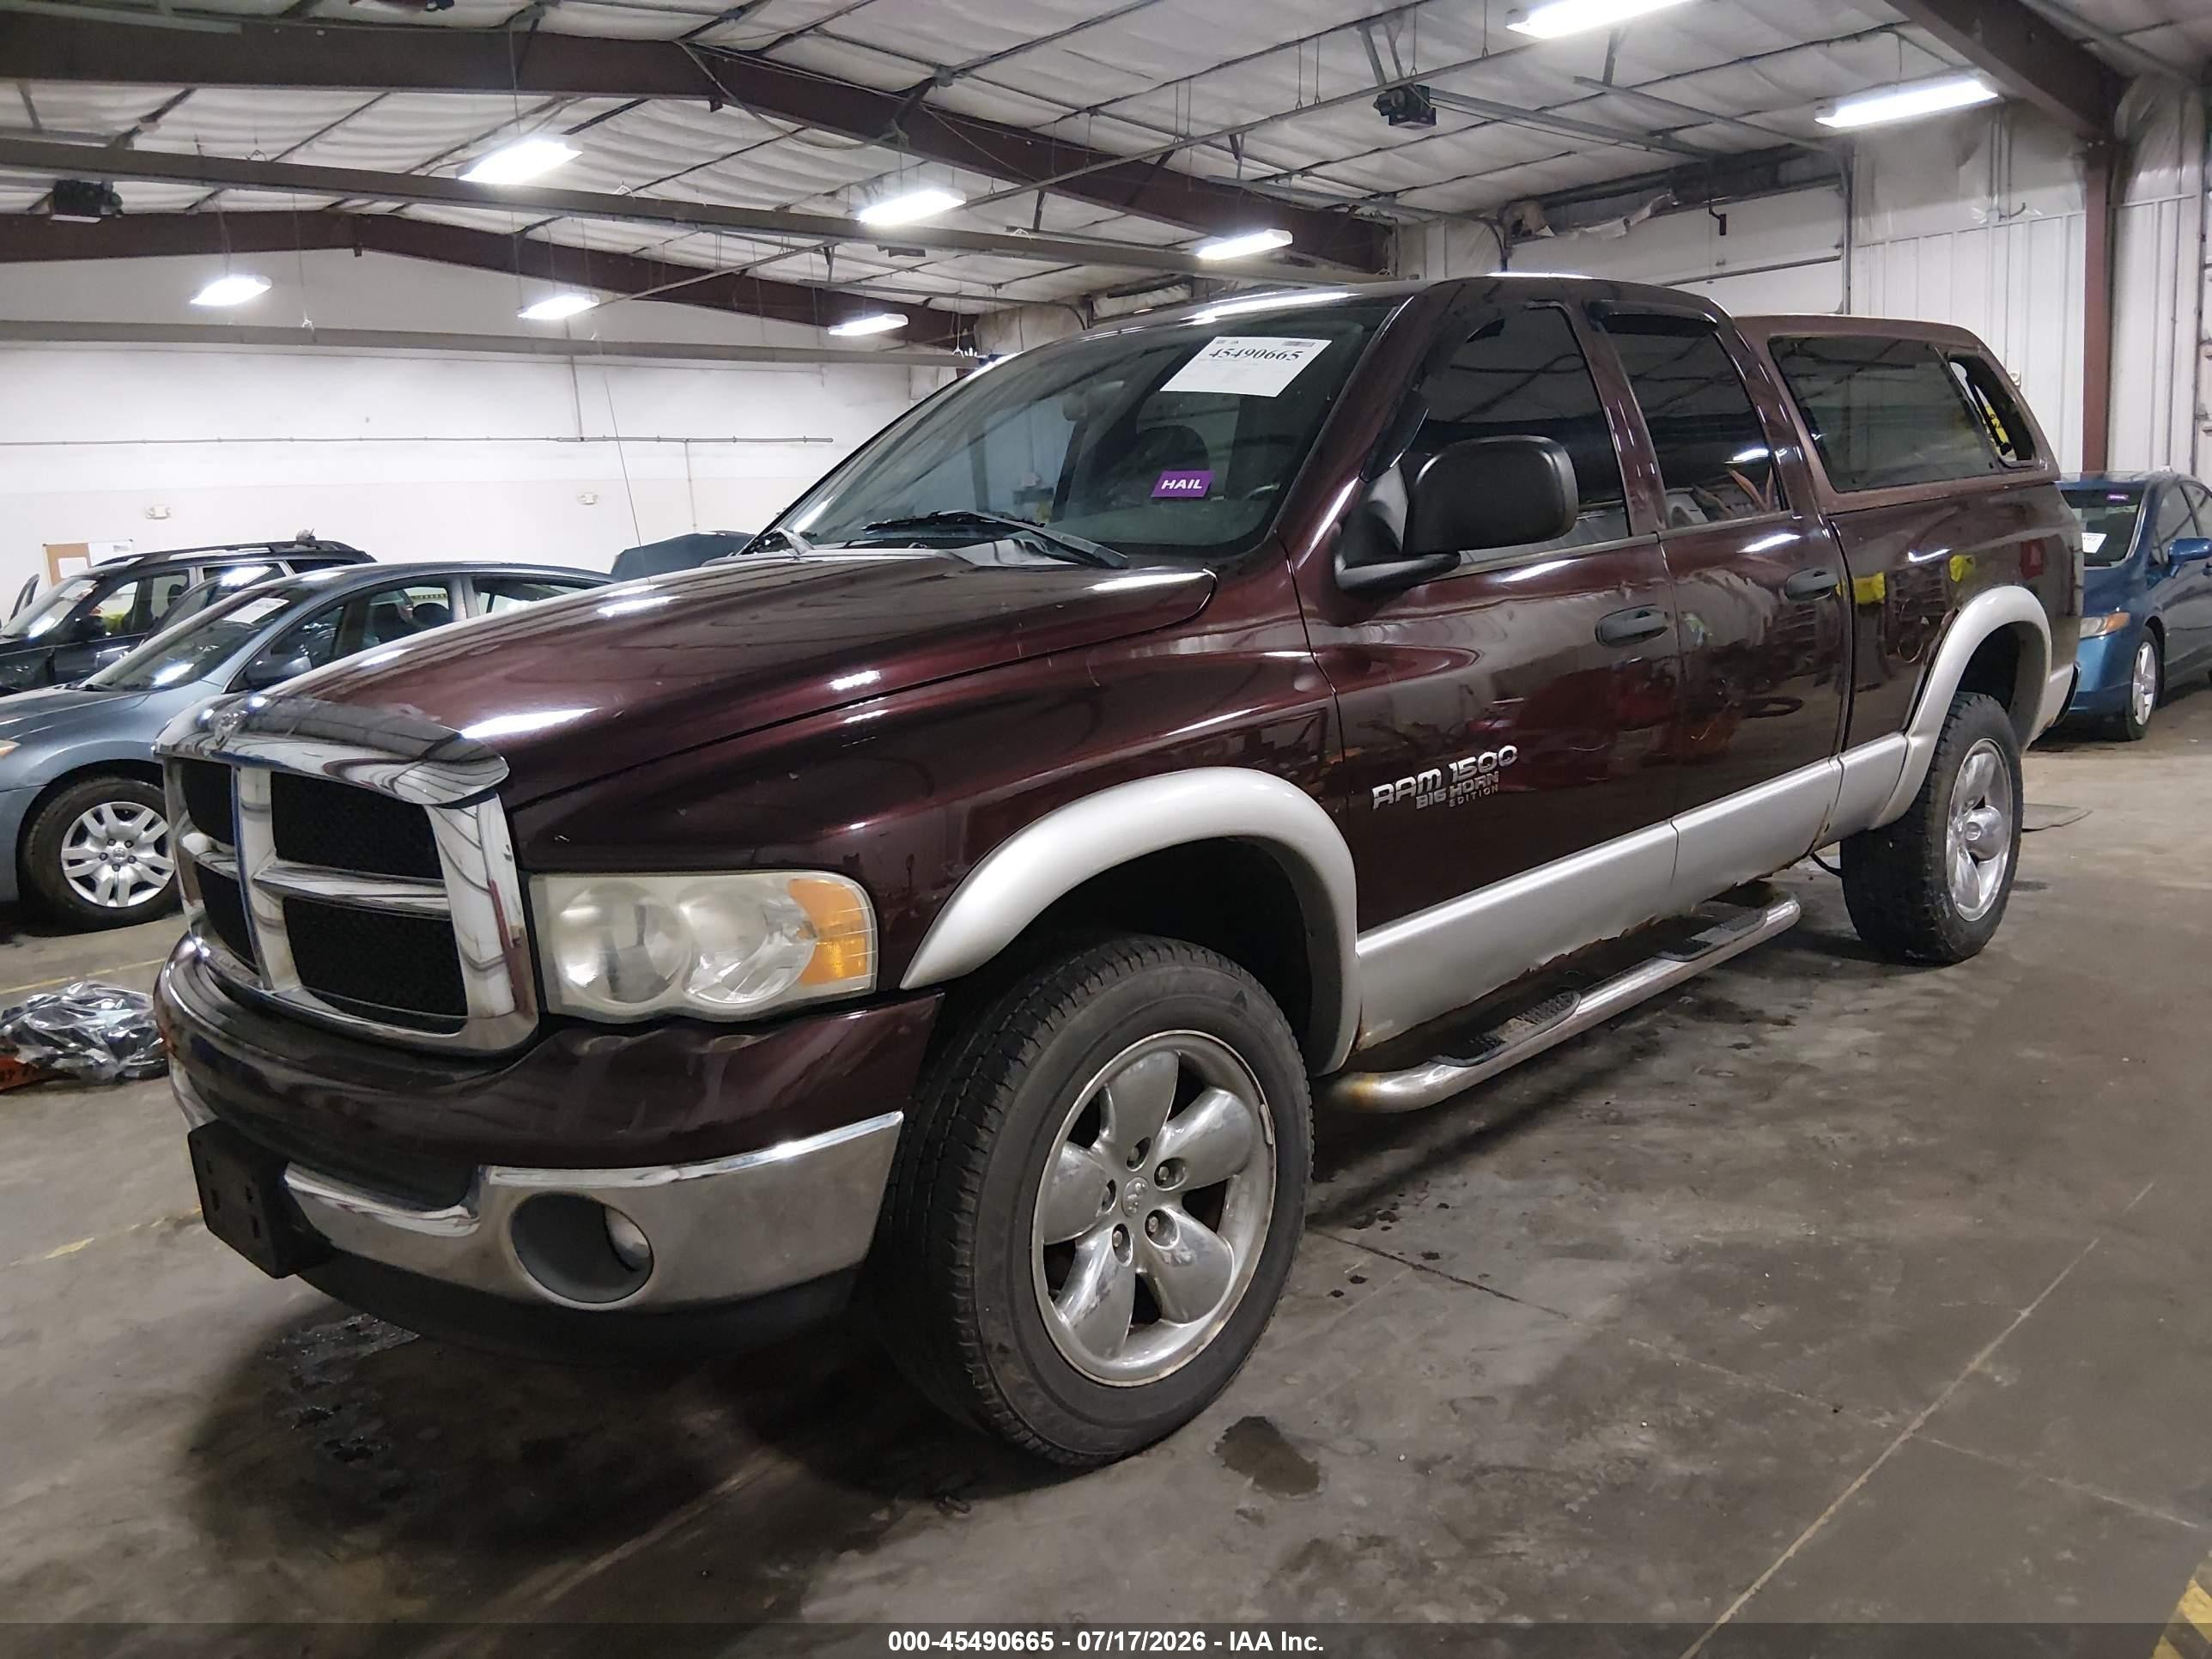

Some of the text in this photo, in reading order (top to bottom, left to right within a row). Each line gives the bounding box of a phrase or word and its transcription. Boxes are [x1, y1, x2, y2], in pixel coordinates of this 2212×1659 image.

[1208, 348, 1304, 362] 45490665
[1161, 478, 1203, 489] HAIL
[1371, 744, 1518, 810] RAM 1500
[1415, 770, 1499, 810] BIG HORN
[1449, 783, 1499, 808] EDITION
